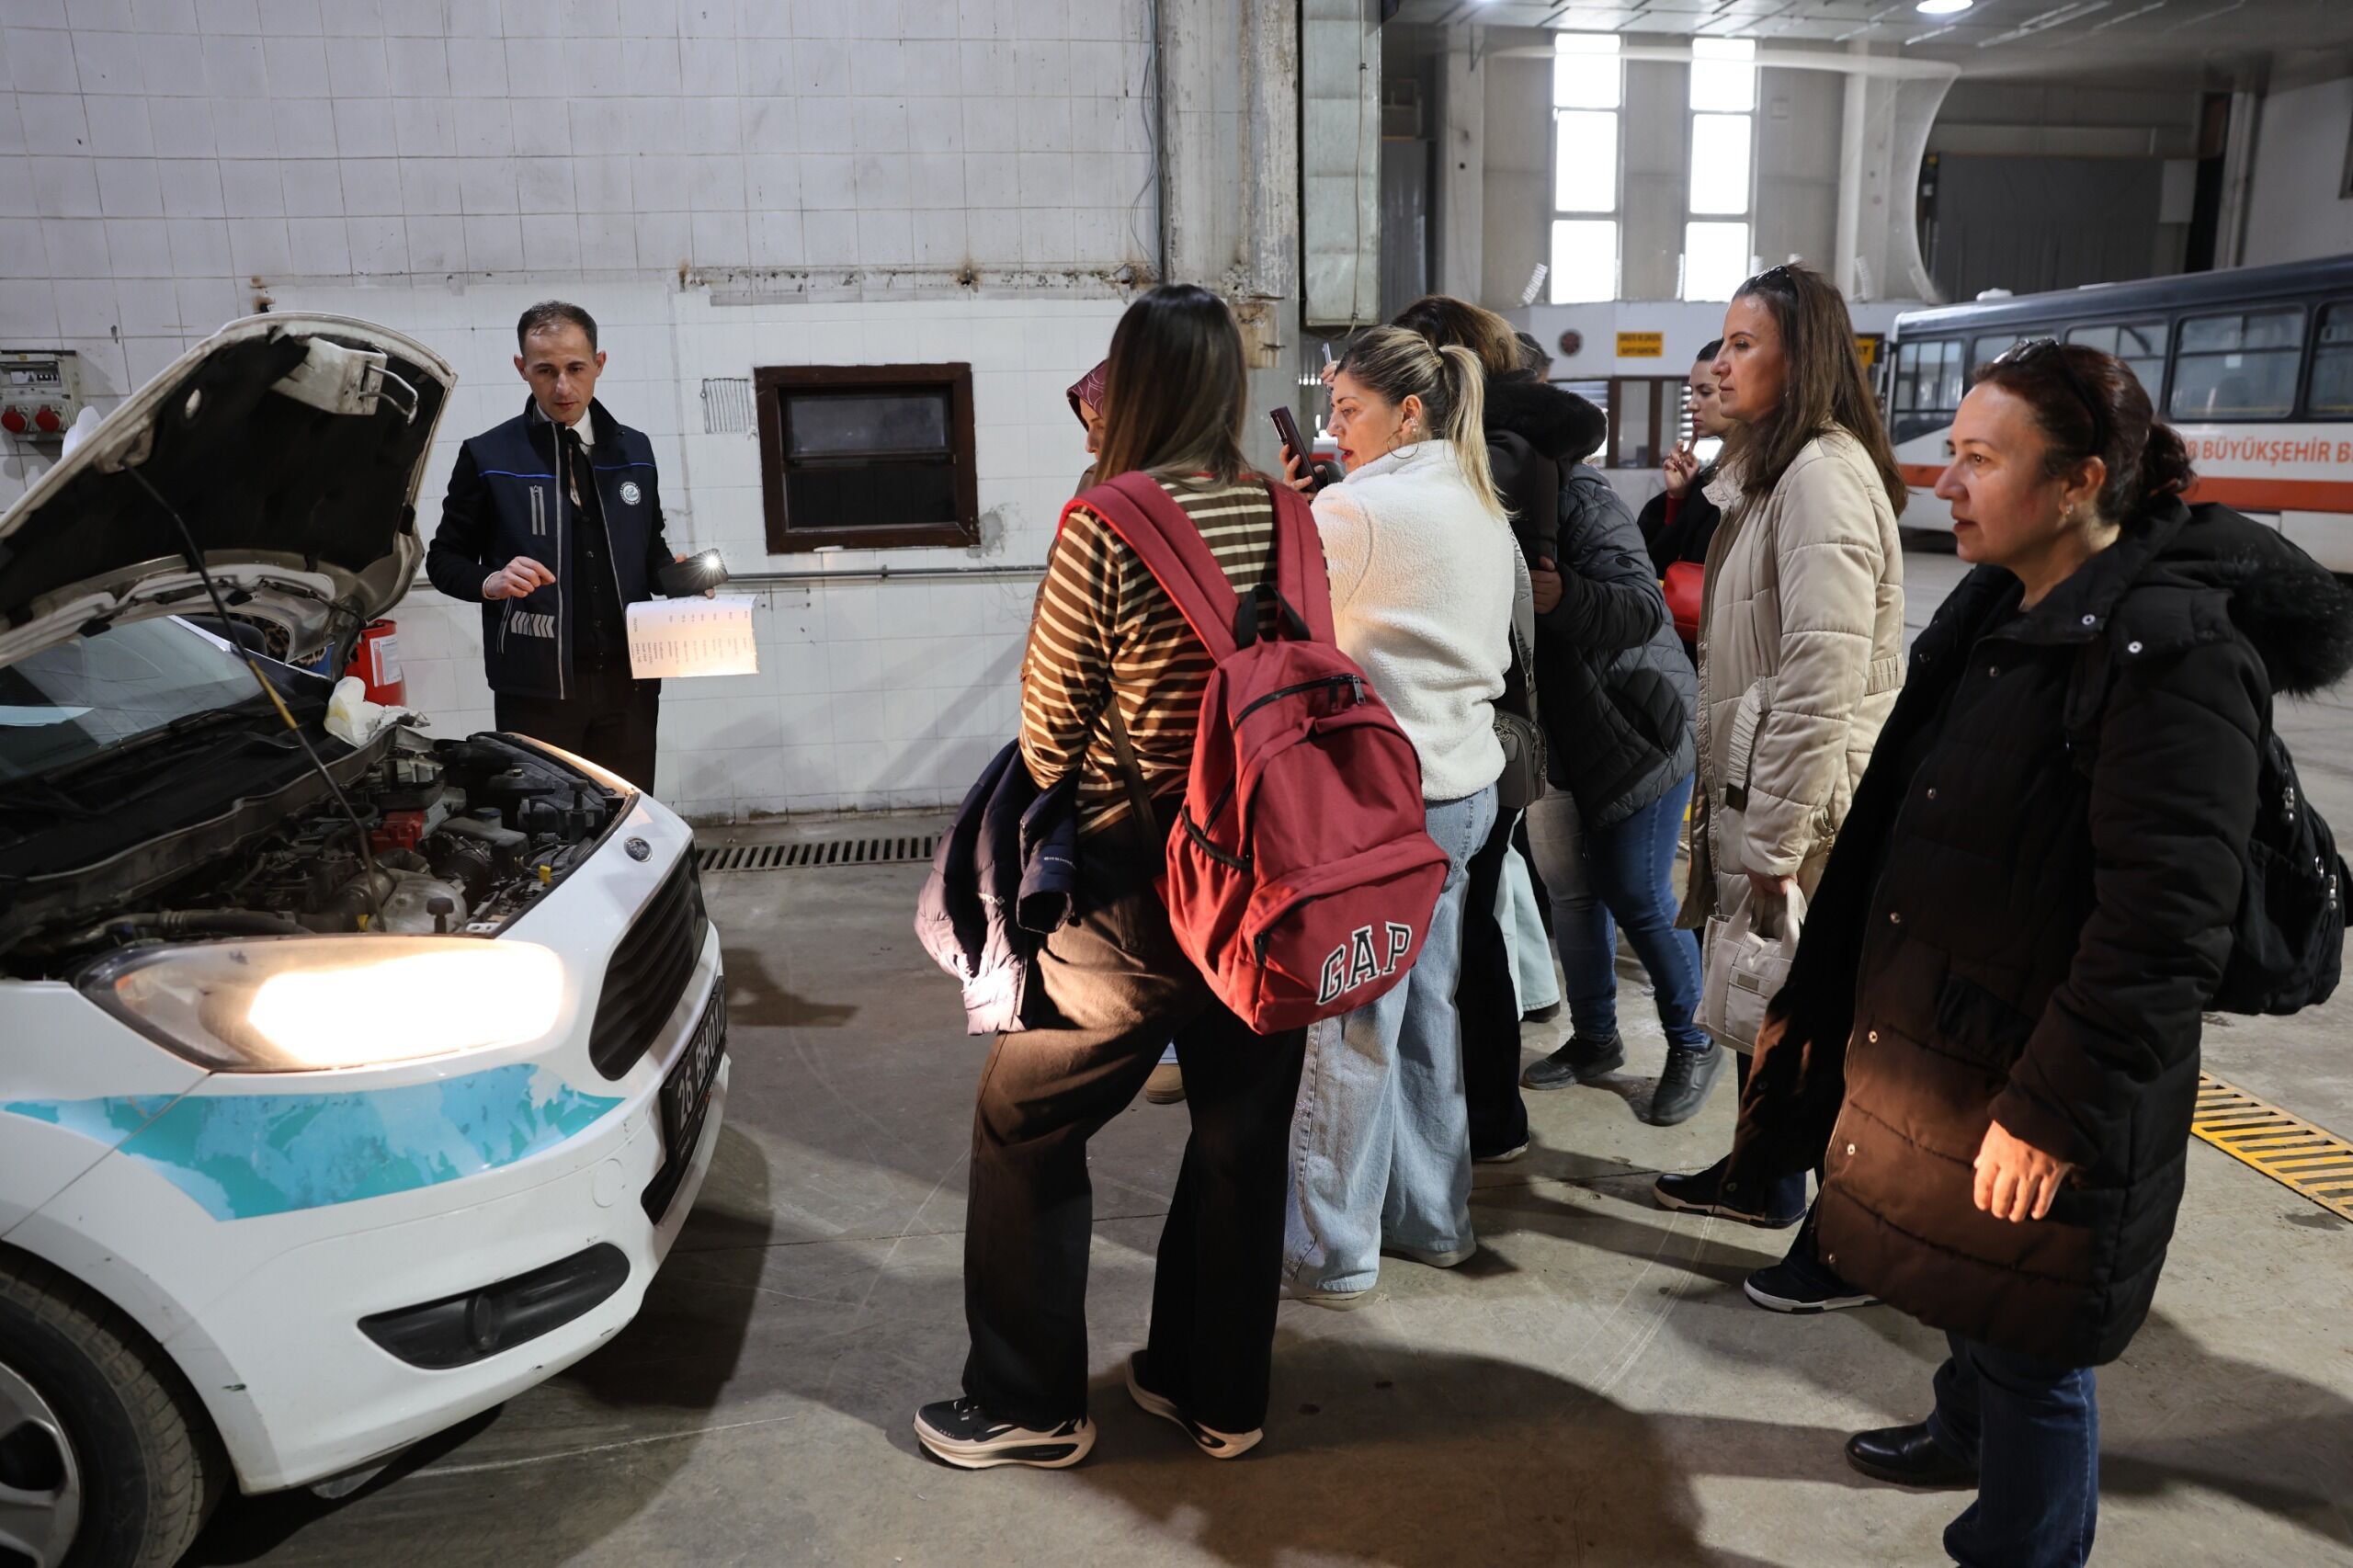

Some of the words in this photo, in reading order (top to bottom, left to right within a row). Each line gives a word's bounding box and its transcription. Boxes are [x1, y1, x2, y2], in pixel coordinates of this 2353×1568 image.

[2202, 436, 2332, 467] BÜYÜKŞEHİR
[2337, 440, 2353, 463] B
[1316, 921, 1412, 1006] GAP
[677, 1065, 693, 1131] 26
